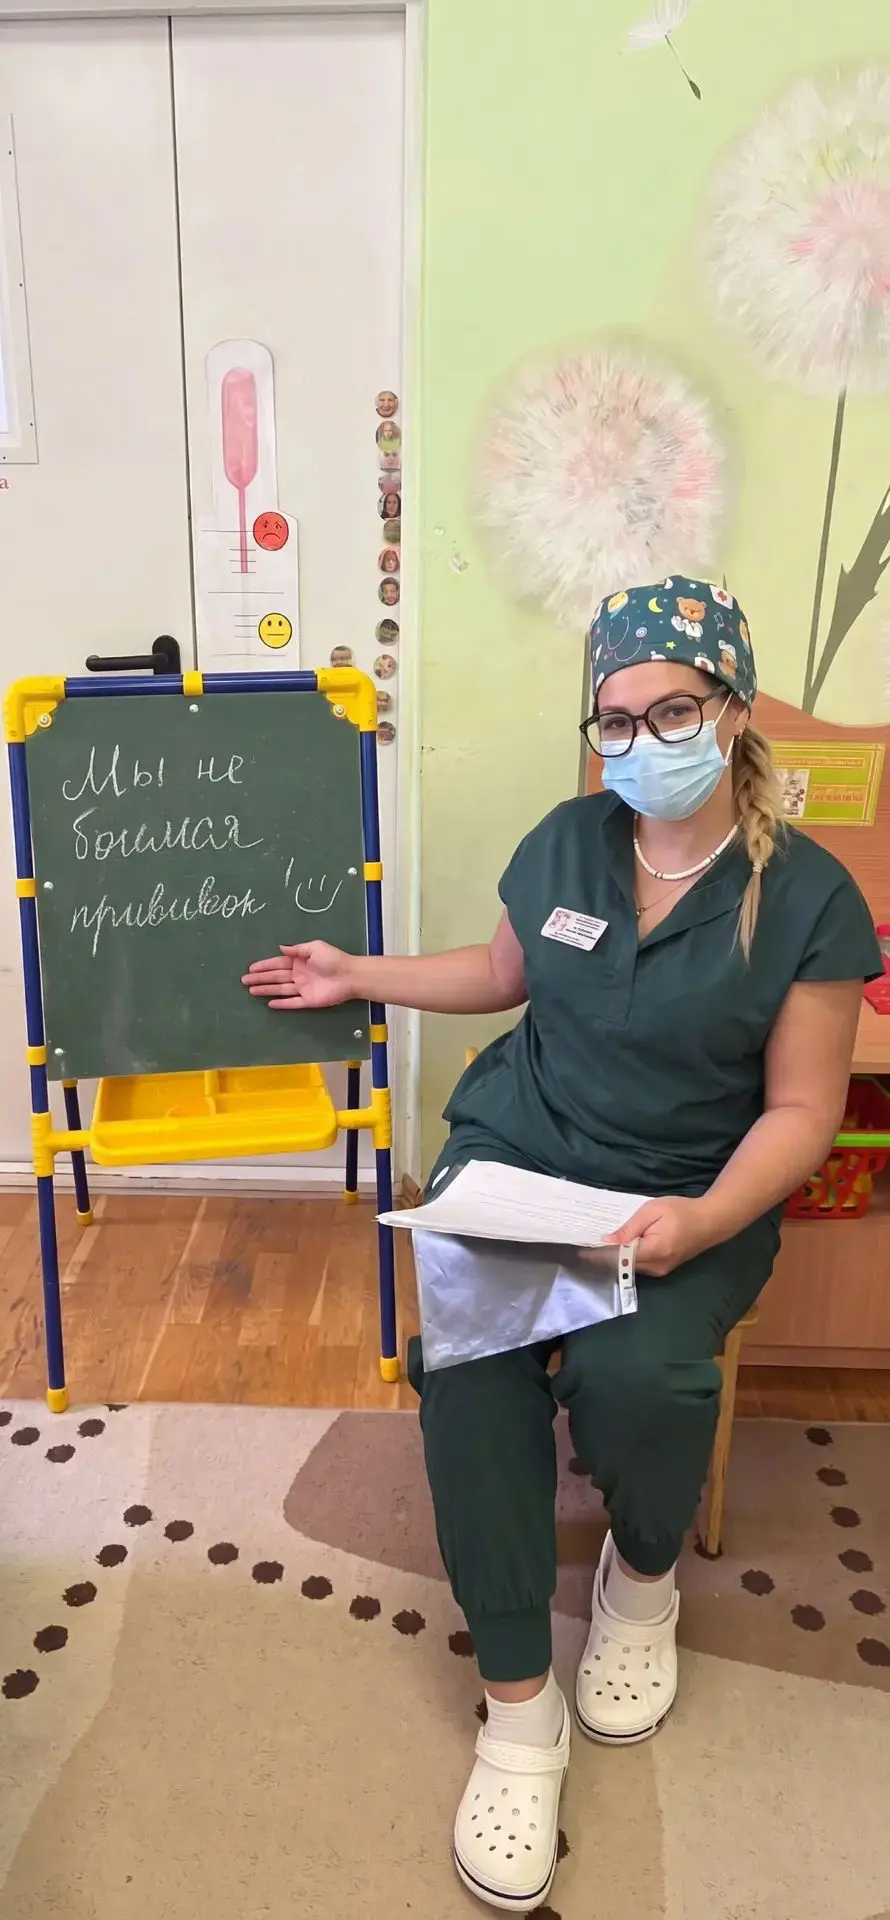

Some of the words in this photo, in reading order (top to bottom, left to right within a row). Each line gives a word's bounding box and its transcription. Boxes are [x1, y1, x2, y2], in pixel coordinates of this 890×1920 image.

[62, 744, 164, 800] Мы
[197, 755, 244, 784] не
[70, 875, 267, 958] прививок
